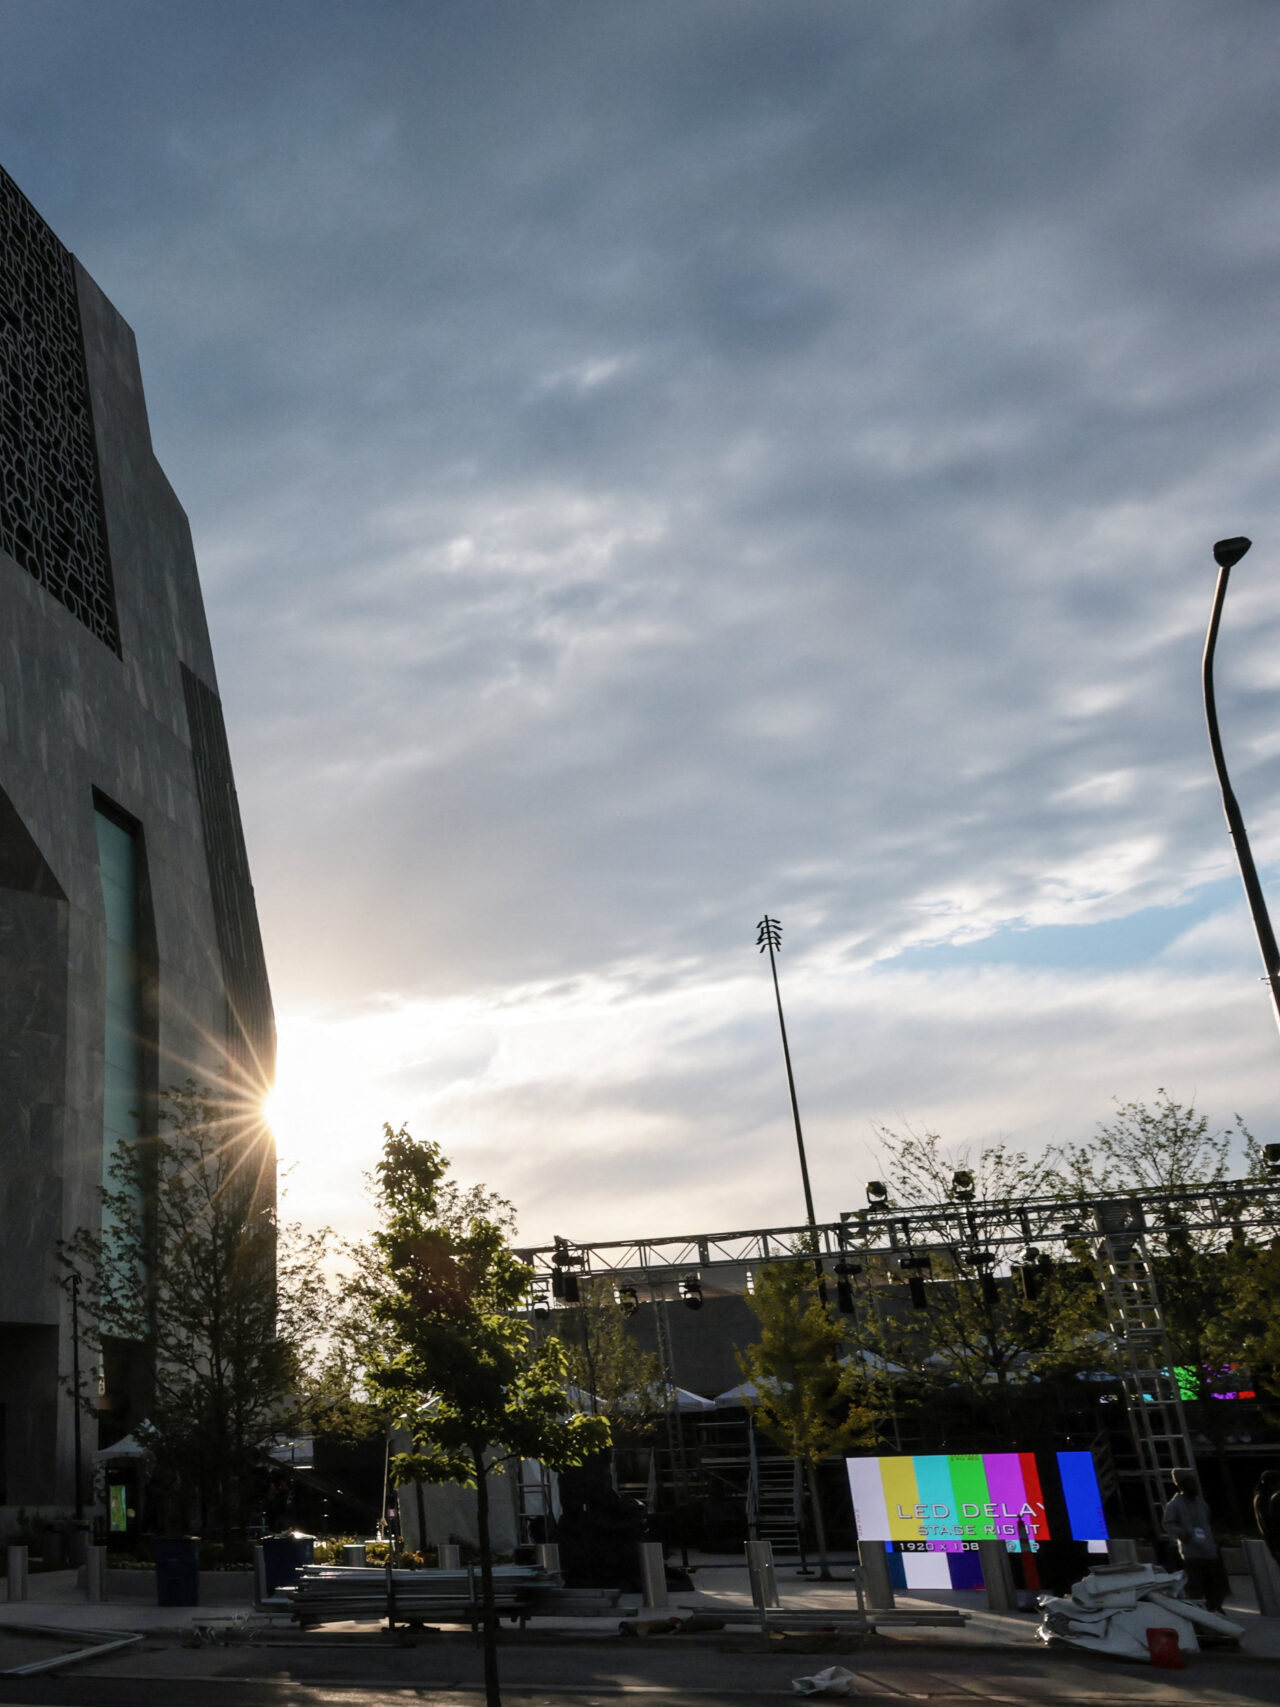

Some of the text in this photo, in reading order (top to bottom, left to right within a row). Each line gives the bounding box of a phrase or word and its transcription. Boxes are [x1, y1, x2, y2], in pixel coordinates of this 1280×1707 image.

[897, 1503, 950, 1519] LED
[917, 1525, 976, 1535] STAGE
[899, 1543, 935, 1551] 1920
